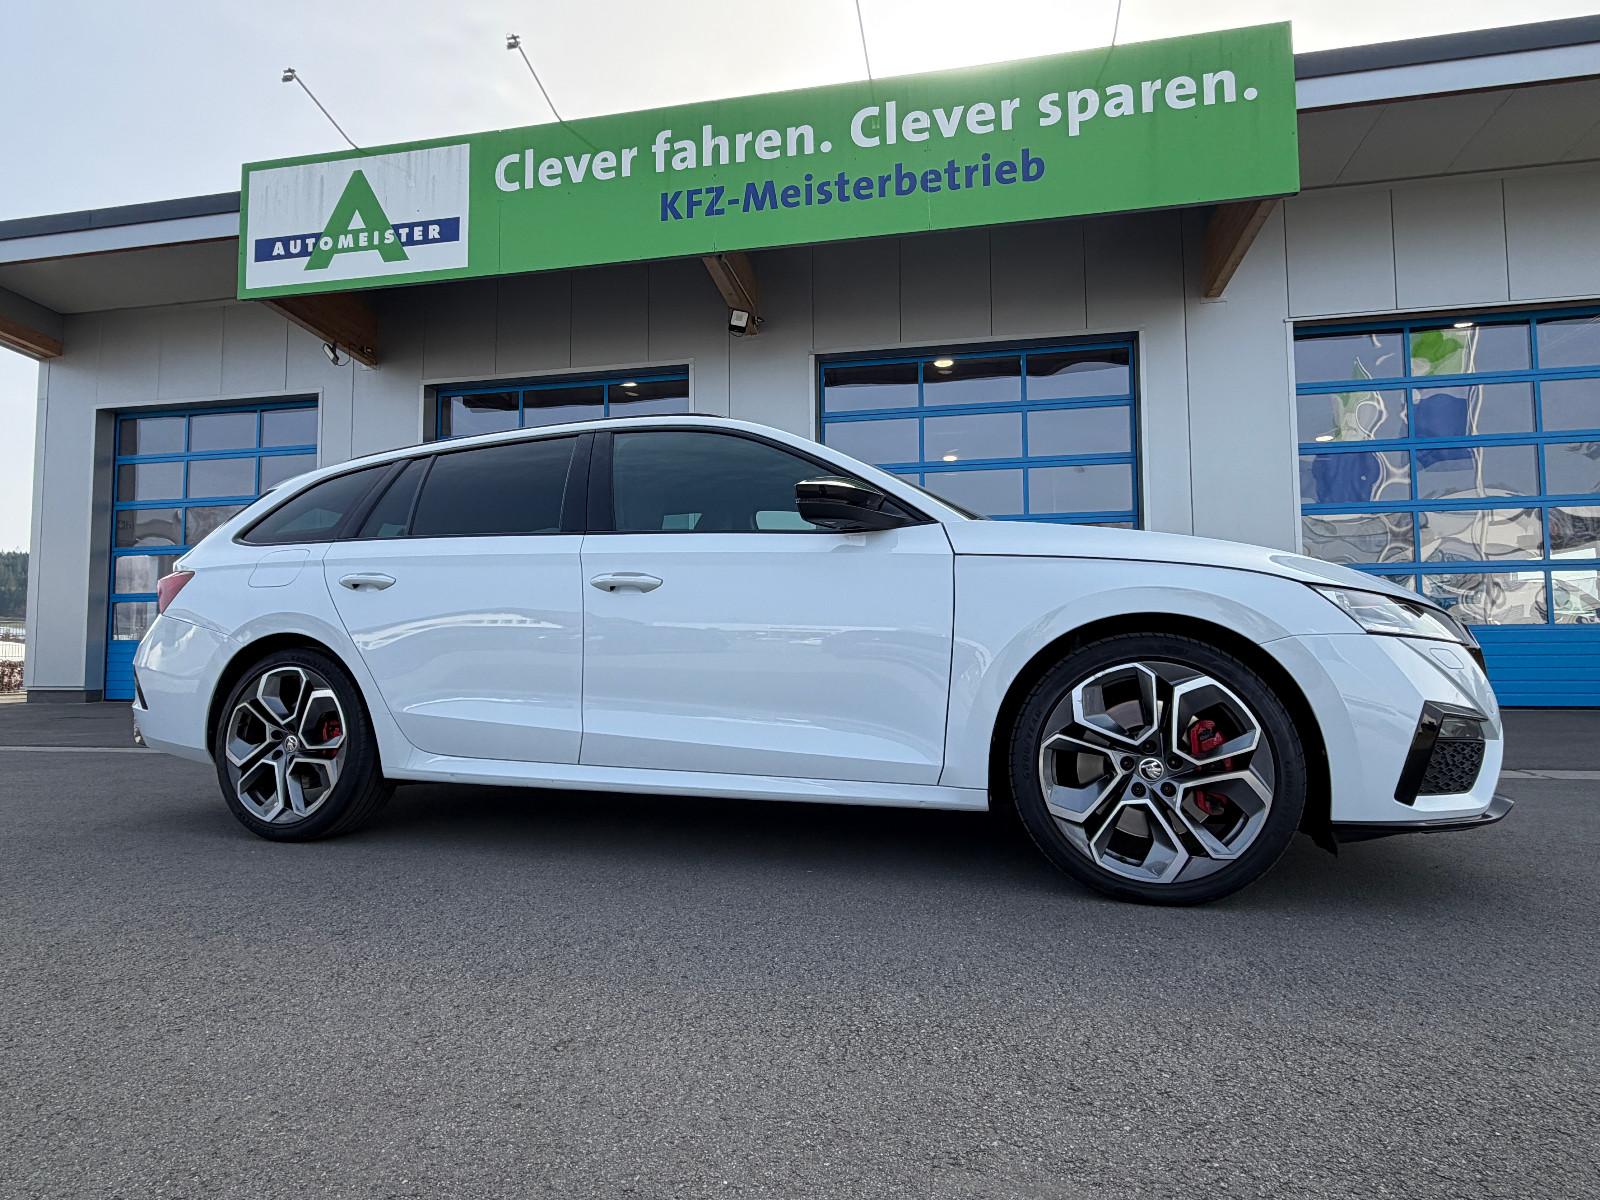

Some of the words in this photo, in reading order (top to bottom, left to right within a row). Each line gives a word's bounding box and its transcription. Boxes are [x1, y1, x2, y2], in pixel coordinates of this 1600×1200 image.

[494, 147, 638, 192] Clever
[652, 124, 833, 173] fahren.
[851, 97, 1021, 149] Clever
[1039, 70, 1259, 137] sparen.
[303, 169, 410, 271] A
[660, 148, 1046, 222] KFZ-Meisterbetrieb
[271, 223, 442, 257] AUTOMEISTER
